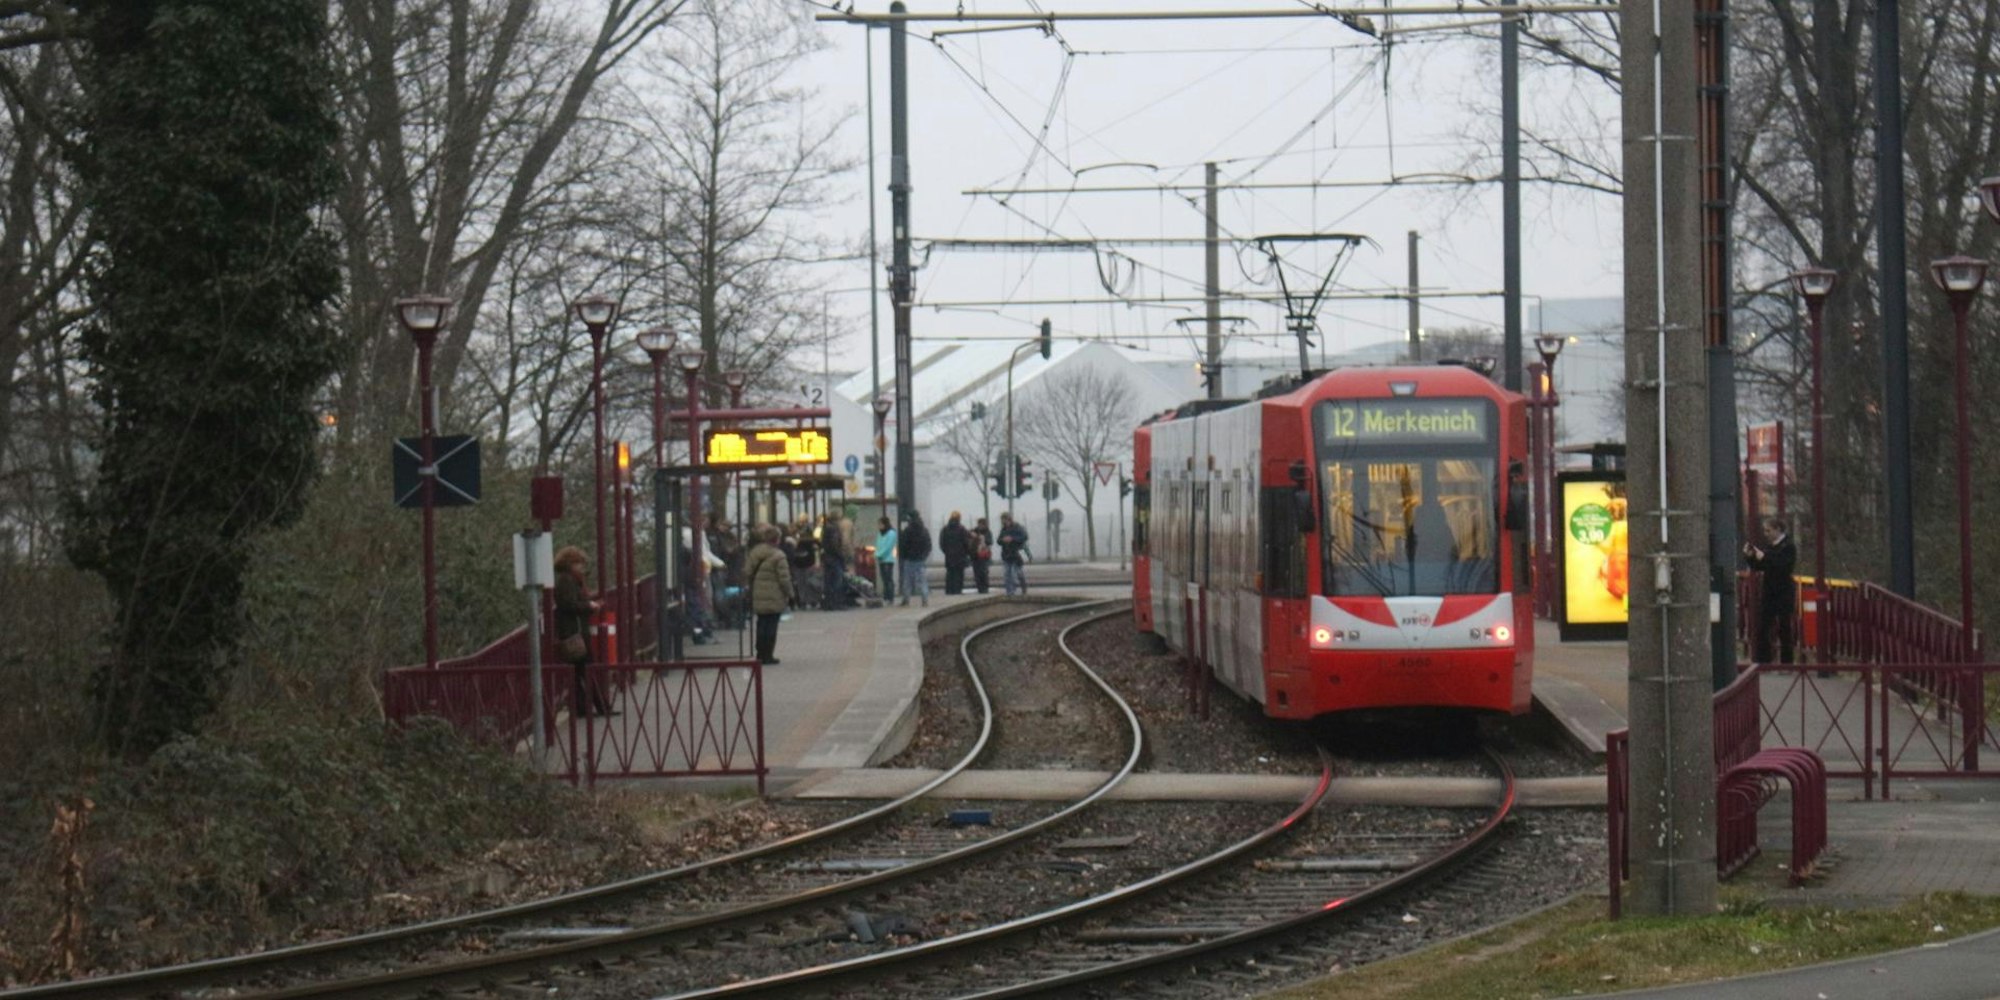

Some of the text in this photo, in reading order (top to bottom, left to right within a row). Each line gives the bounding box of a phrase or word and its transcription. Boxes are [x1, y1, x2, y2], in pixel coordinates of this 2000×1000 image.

[811, 387, 823, 404] 2
[1333, 408, 1477, 437] 12 Merkenich
